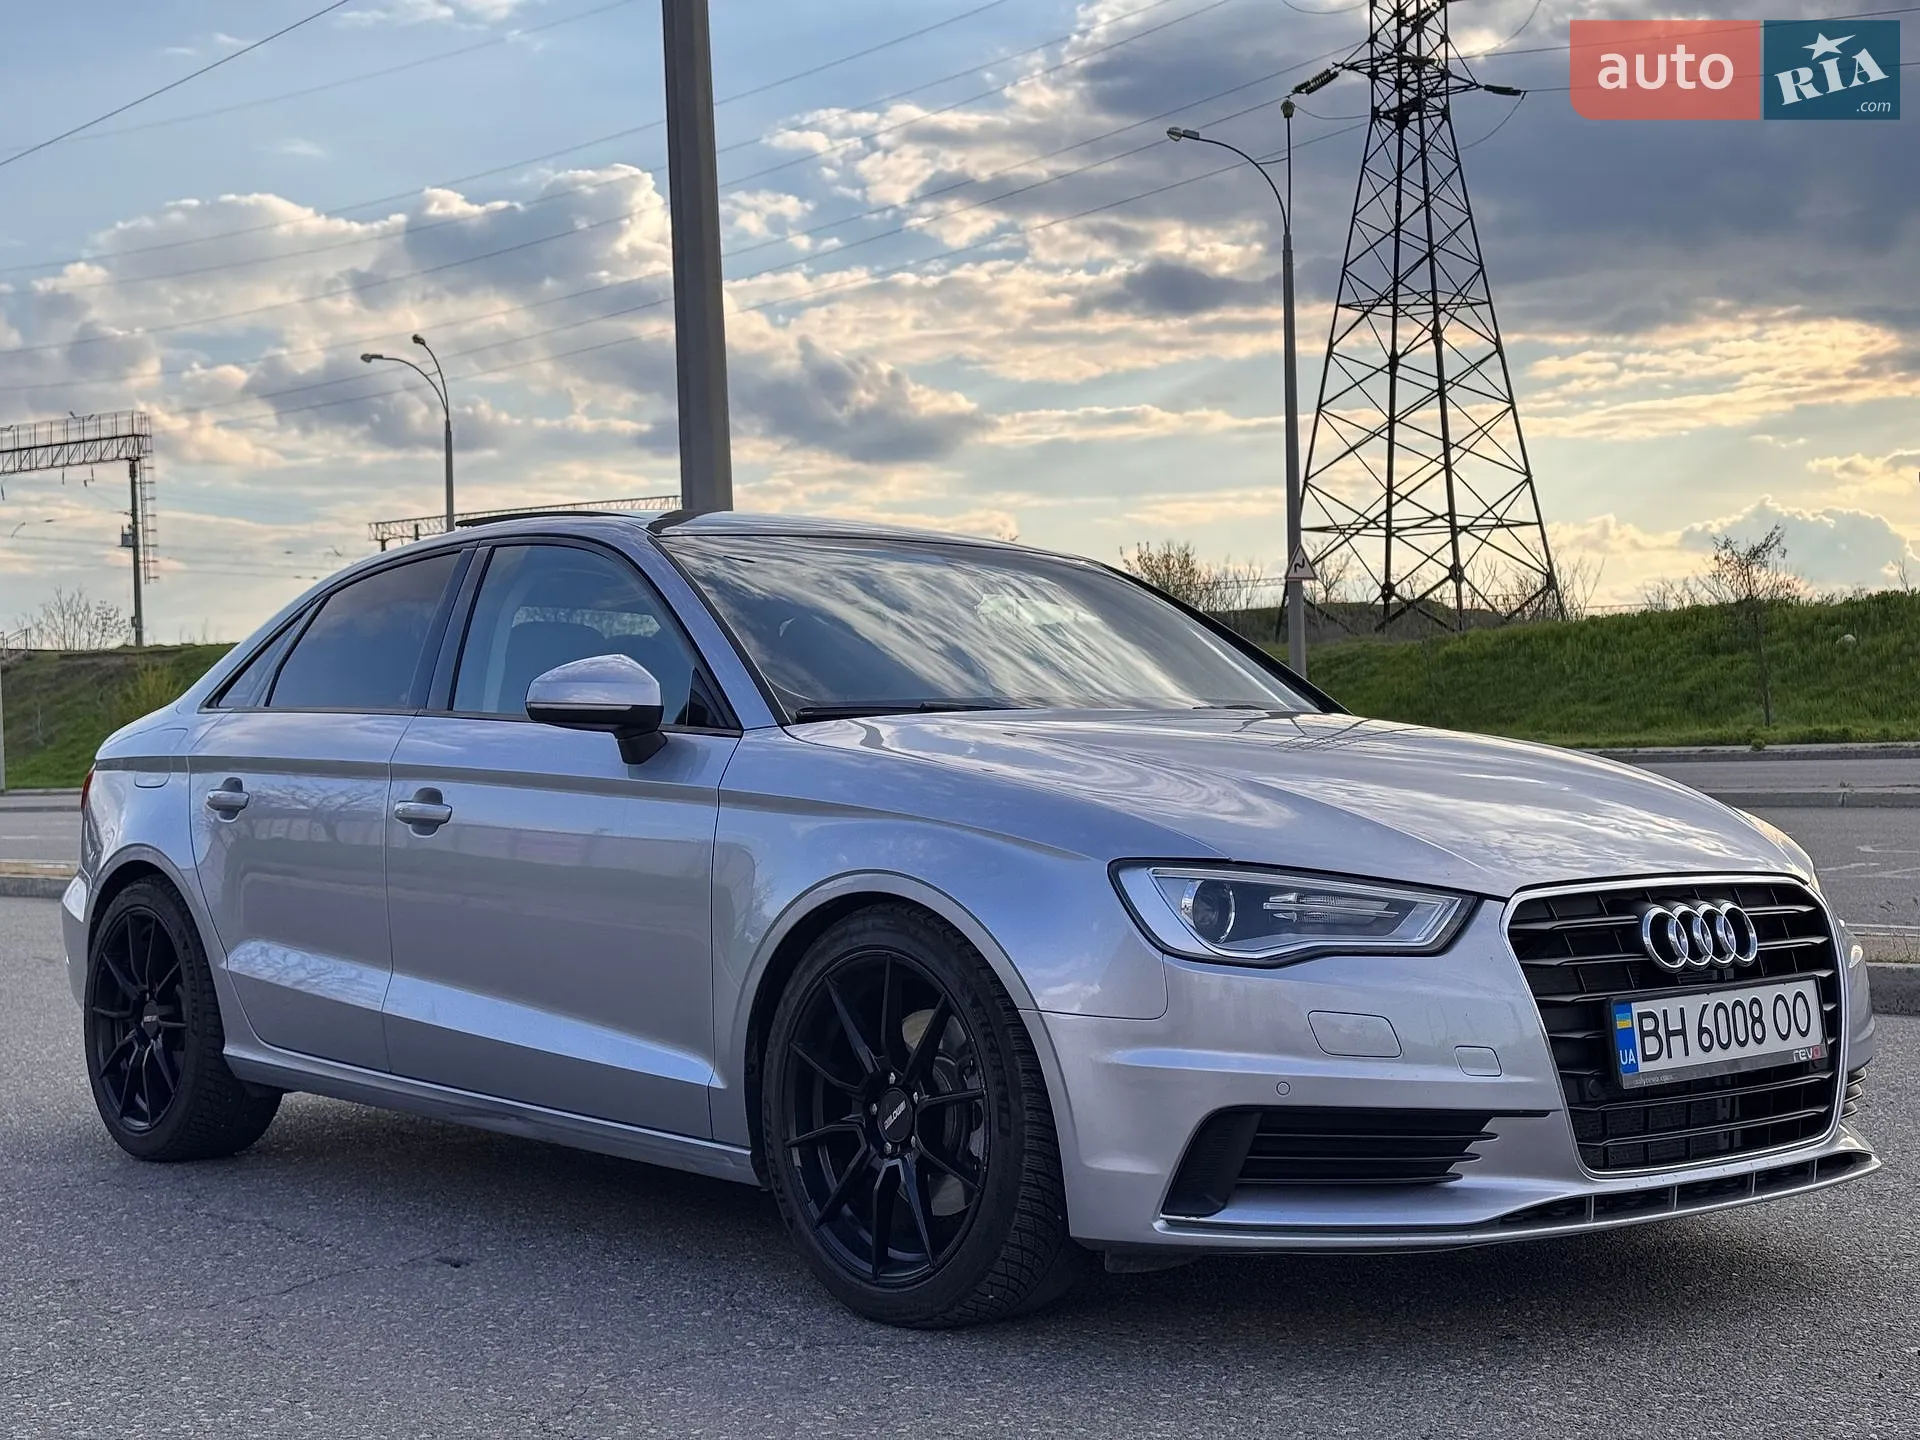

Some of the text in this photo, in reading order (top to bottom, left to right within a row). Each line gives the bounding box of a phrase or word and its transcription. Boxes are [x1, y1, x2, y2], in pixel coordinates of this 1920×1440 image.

[1637, 990, 1811, 1063] BH 6008 OO
[1619, 1049, 1636, 1066] UA
